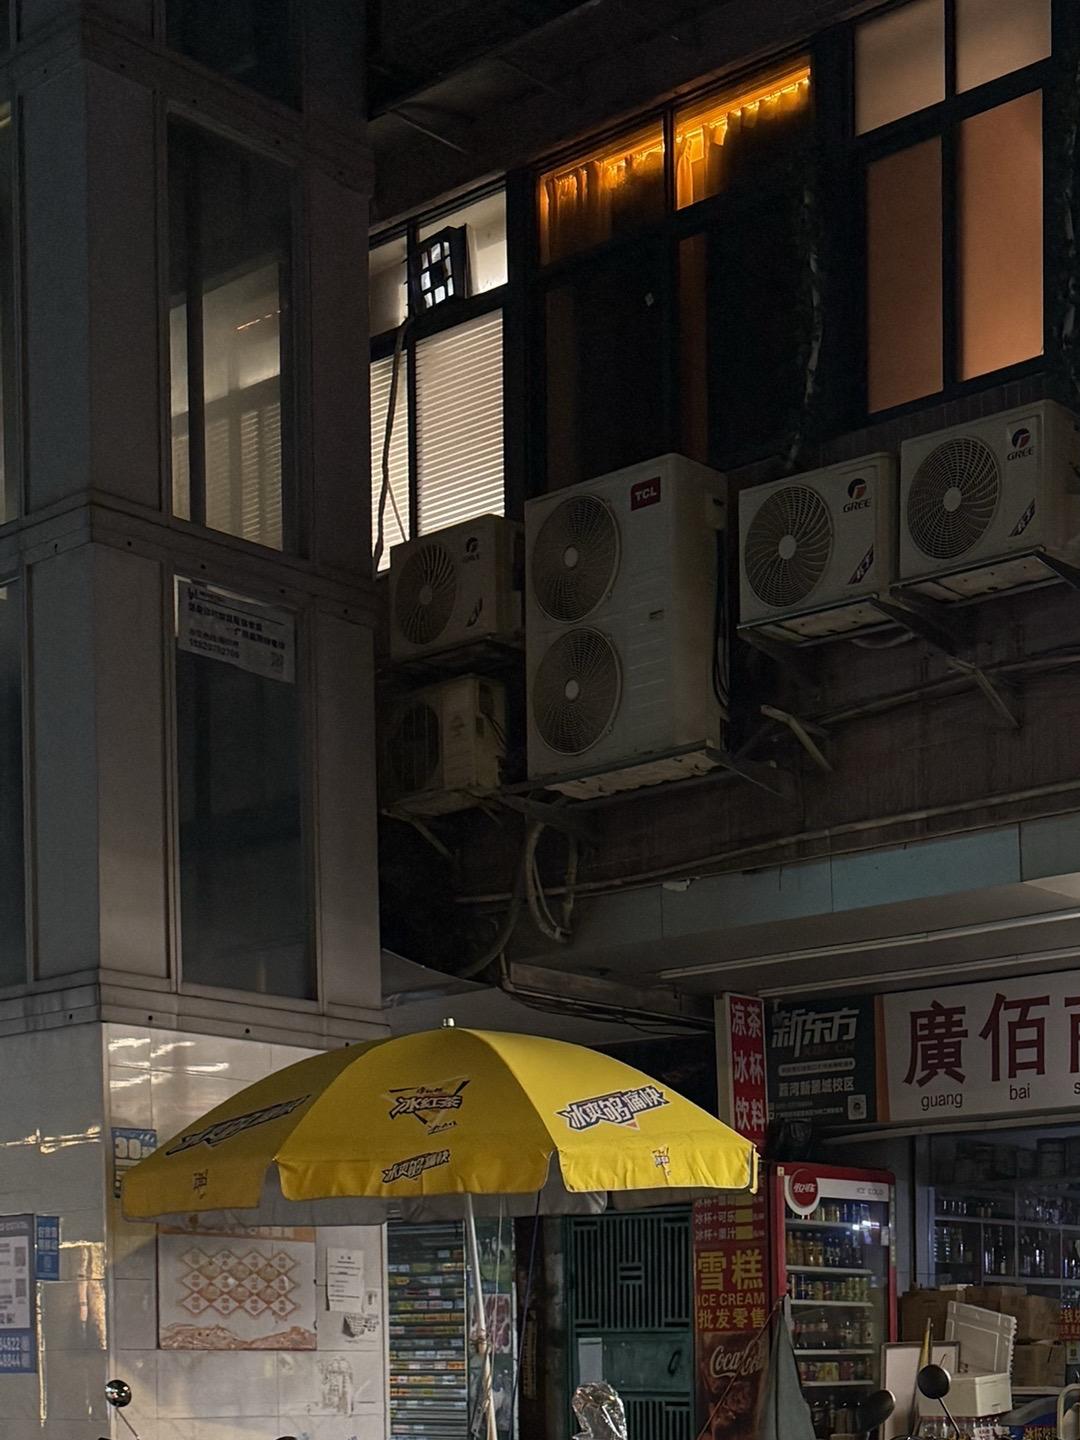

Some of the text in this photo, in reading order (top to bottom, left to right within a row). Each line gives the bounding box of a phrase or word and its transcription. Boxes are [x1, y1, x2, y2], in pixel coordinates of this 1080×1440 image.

[1006, 446, 1034, 462] GREE
[634, 486, 658, 502] TCL
[843, 497, 871, 513] GREE
[731, 1002, 762, 1038] 凉茶
[771, 1007, 860, 1058] 新东方
[733, 1051, 764, 1086] 冰杯
[920, 1092, 964, 1111] guang
[1009, 1083, 1031, 1100] bai
[558, 1086, 669, 1129] 冰爽够痛快
[735, 1097, 766, 1132] 饮料
[697, 1248, 763, 1292] 雪糕
[697, 1292, 766, 1307] ICE CREAM
[698, 1307, 766, 1330] 批发零售
